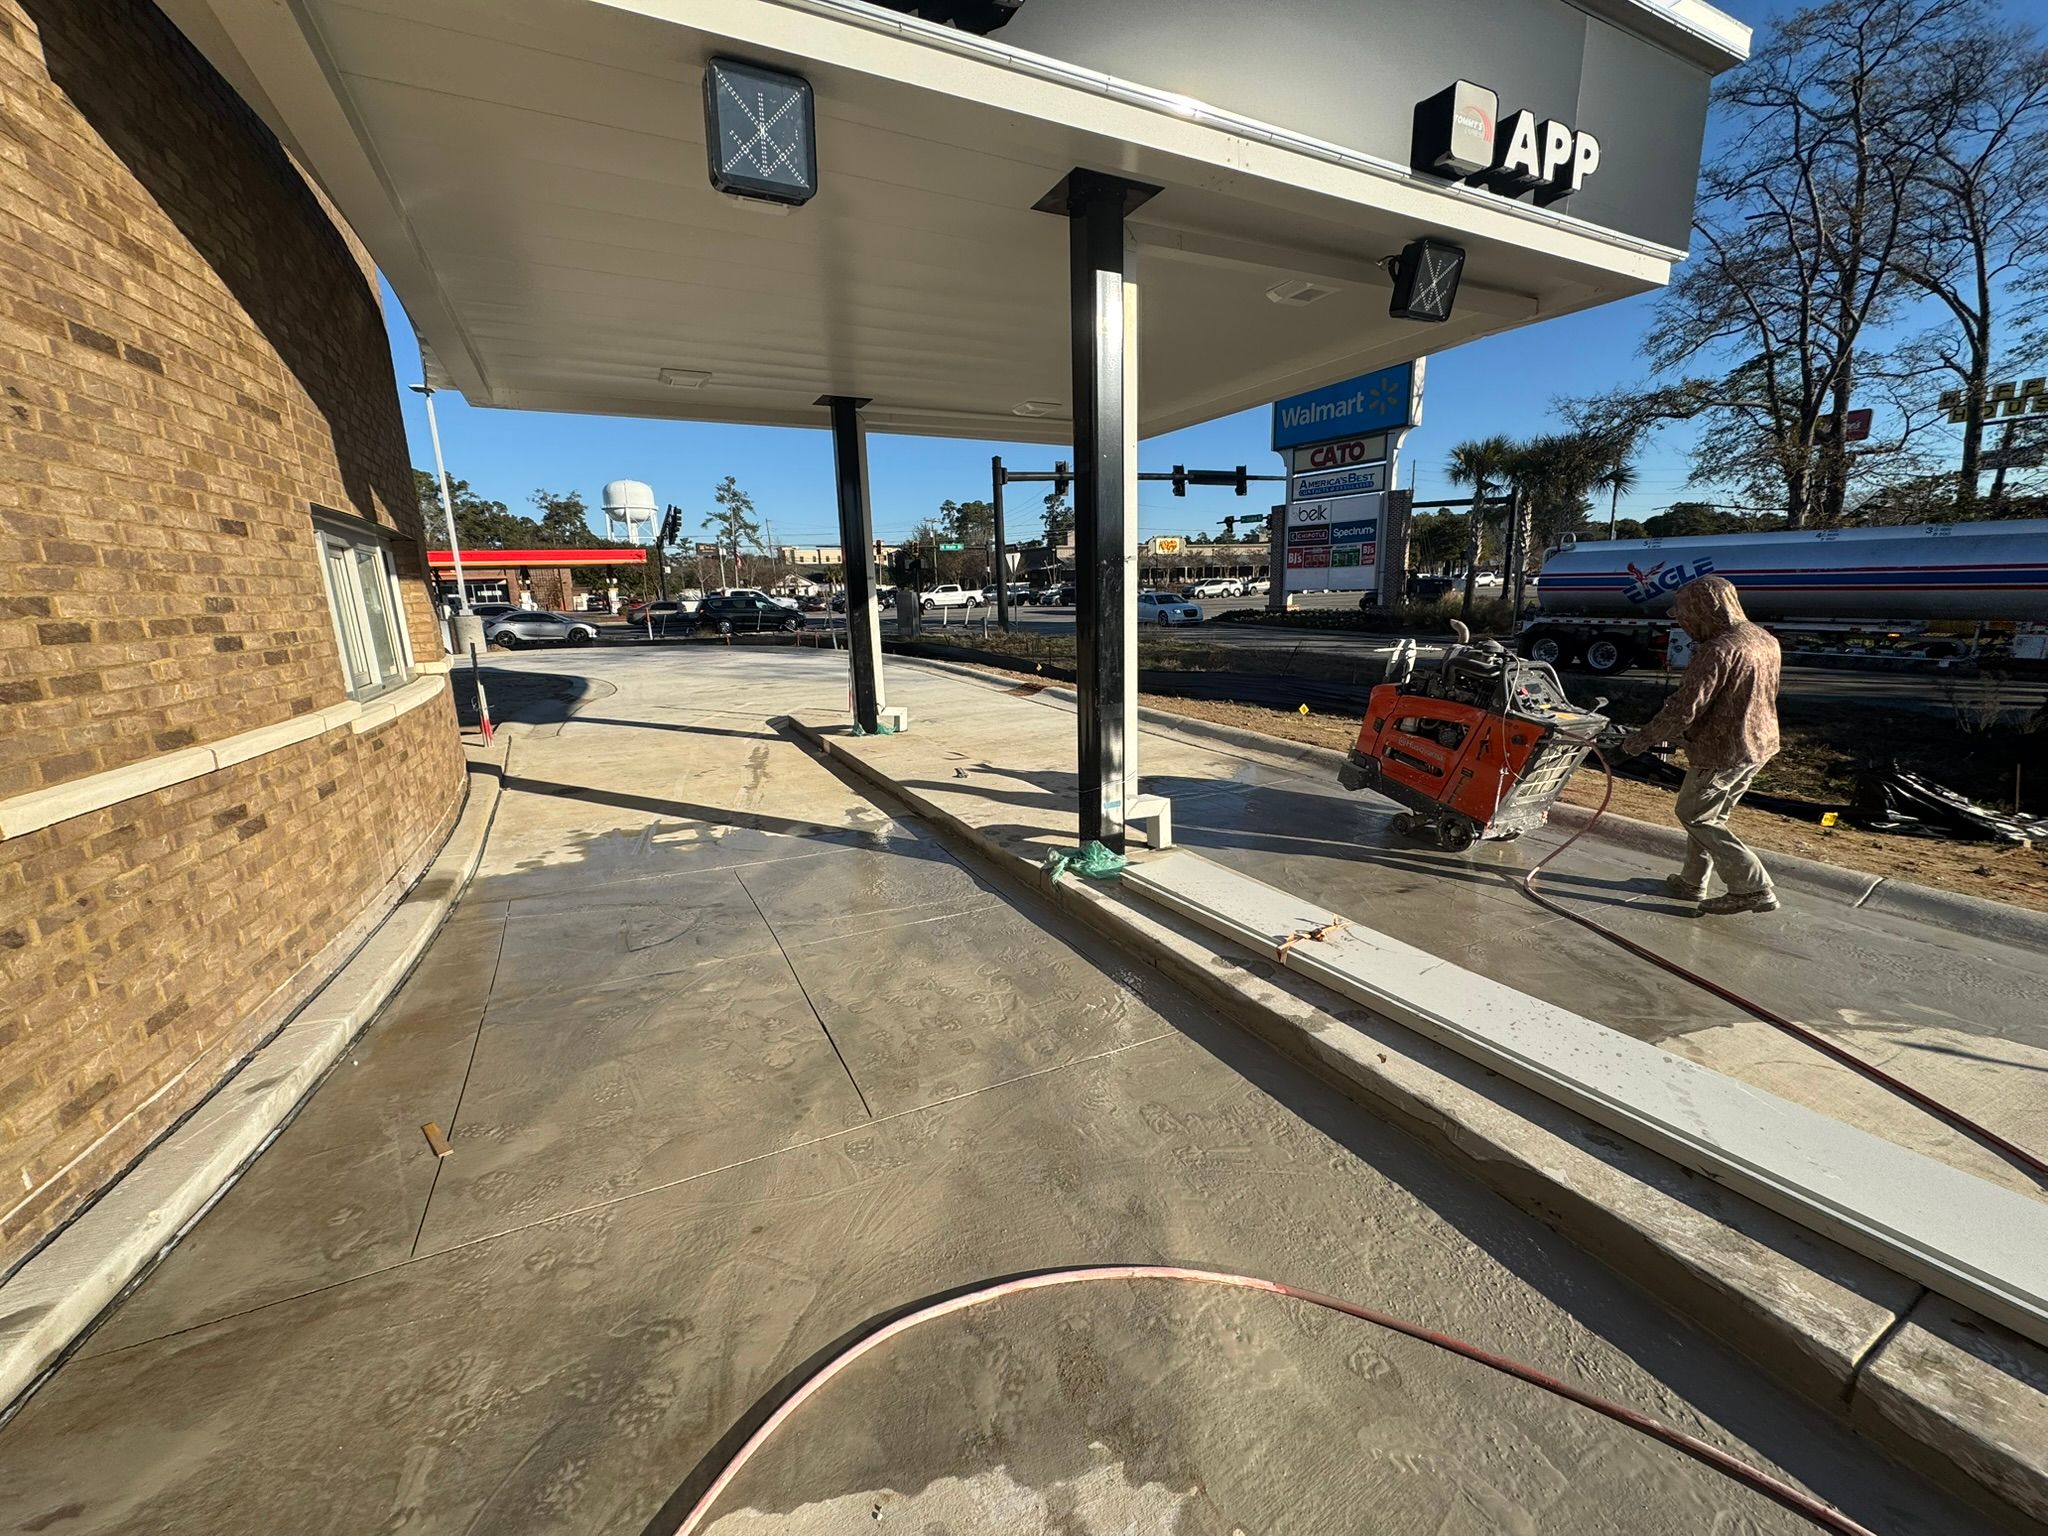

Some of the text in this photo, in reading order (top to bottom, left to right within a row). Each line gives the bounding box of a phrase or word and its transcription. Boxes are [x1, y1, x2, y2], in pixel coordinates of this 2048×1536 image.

[1504, 110, 1600, 191] APP
[1282, 391, 1364, 429] Walmart
[1310, 441, 1366, 467] CATO
[1347, 472, 1375, 483] BEST
[1298, 505, 1328, 521] belk
[1333, 526, 1372, 538] Spectrum
[1288, 551, 1302, 564] BJ's
[1623, 556, 1715, 604] EAGLE
